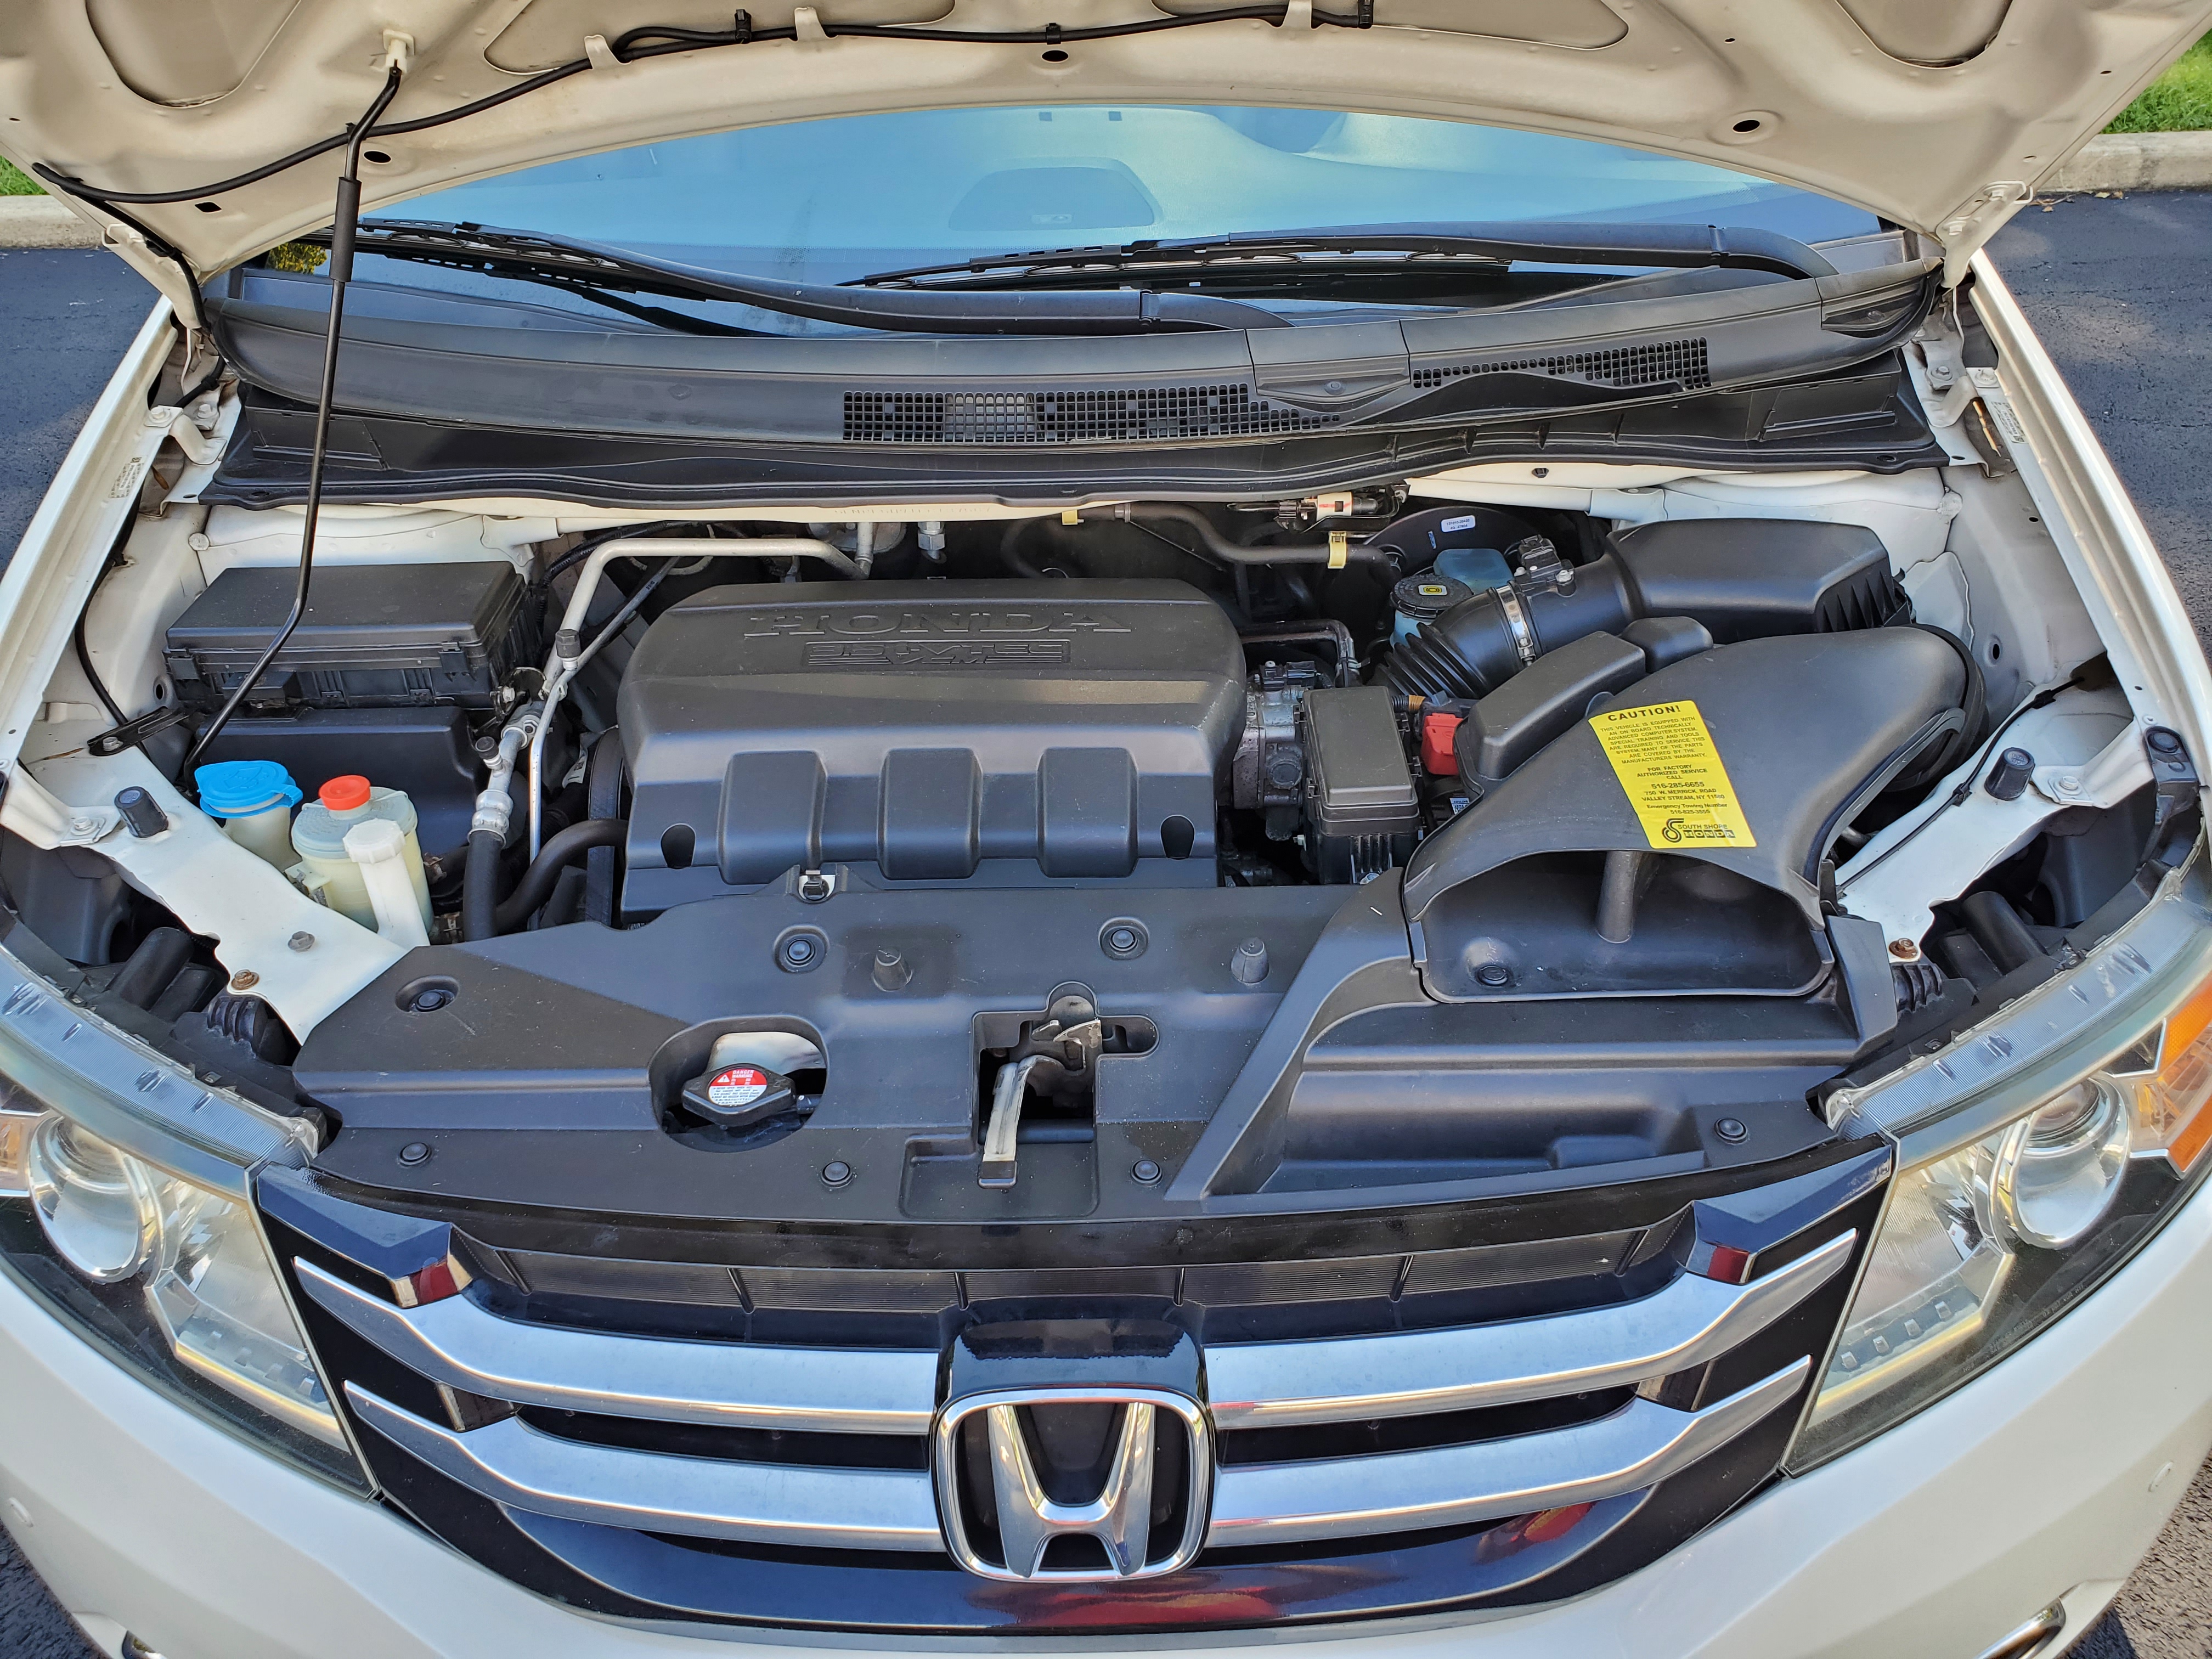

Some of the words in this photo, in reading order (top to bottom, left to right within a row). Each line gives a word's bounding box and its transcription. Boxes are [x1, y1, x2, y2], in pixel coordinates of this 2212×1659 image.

[744, 612, 1132, 637] HONDA
[1608, 706, 1681, 721] CAUTION!
[1683, 830, 1736, 838] HONDA
